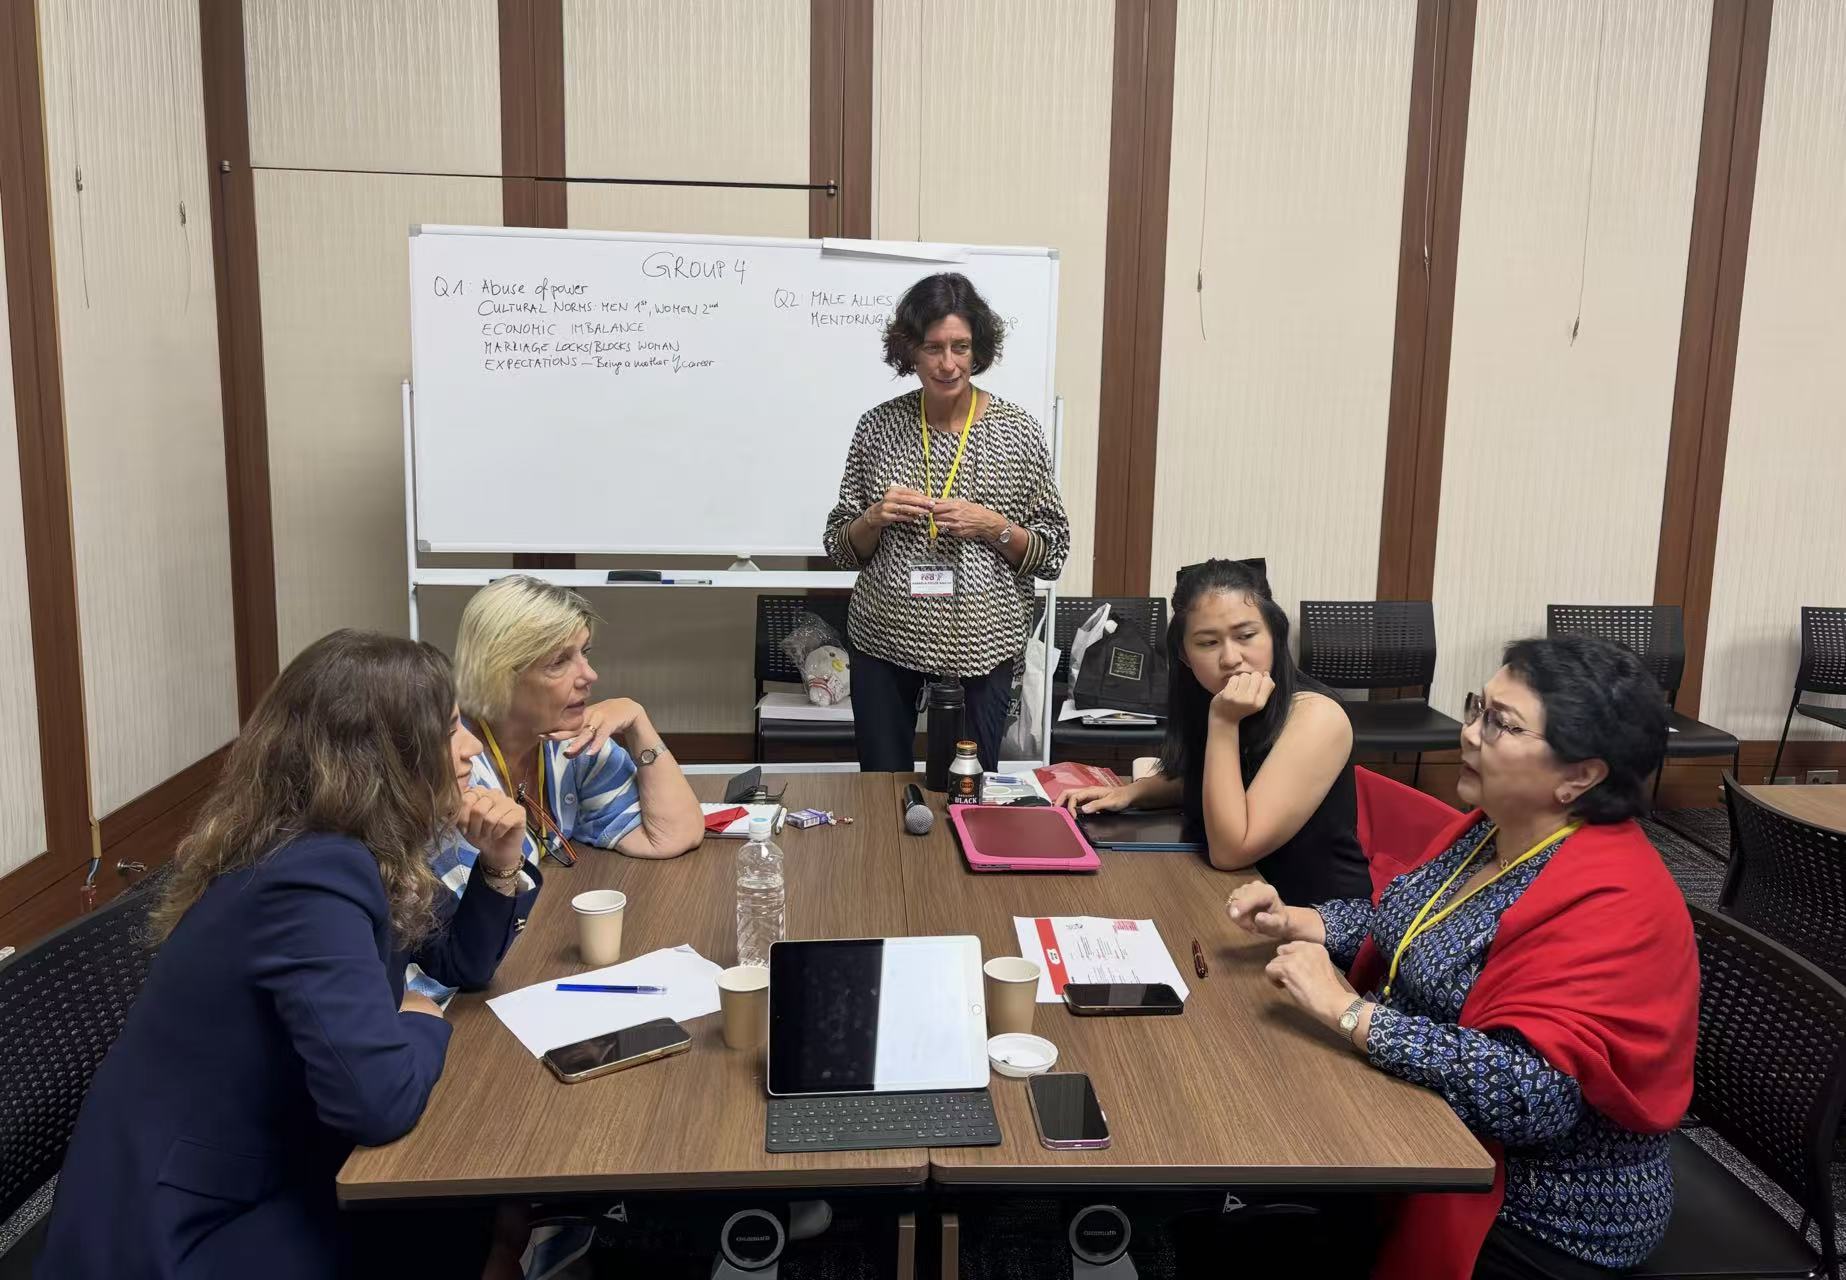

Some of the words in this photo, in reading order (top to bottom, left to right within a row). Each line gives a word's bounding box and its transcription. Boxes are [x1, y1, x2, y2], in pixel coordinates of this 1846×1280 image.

[642, 252, 725, 279] GROUP
[734, 259, 746, 285] 4
[482, 279, 526, 296] Abuse
[534, 277, 549, 301] of
[551, 284, 589, 300] power
[810, 290, 847, 307] MALE
[478, 299, 548, 317] CULTURAL
[601, 302, 629, 313] MEN
[654, 303, 698, 315] WOMEN
[811, 311, 884, 328] MENTORING
[481, 322, 557, 336] ECONOMIC
[571, 321, 645, 336] IMBALANCE
[638, 340, 680, 353] WOMAN
[592, 355, 622, 375] Being
[633, 356, 669, 369] mother
[681, 360, 715, 369] career
[954, 796, 978, 804] BLACK
